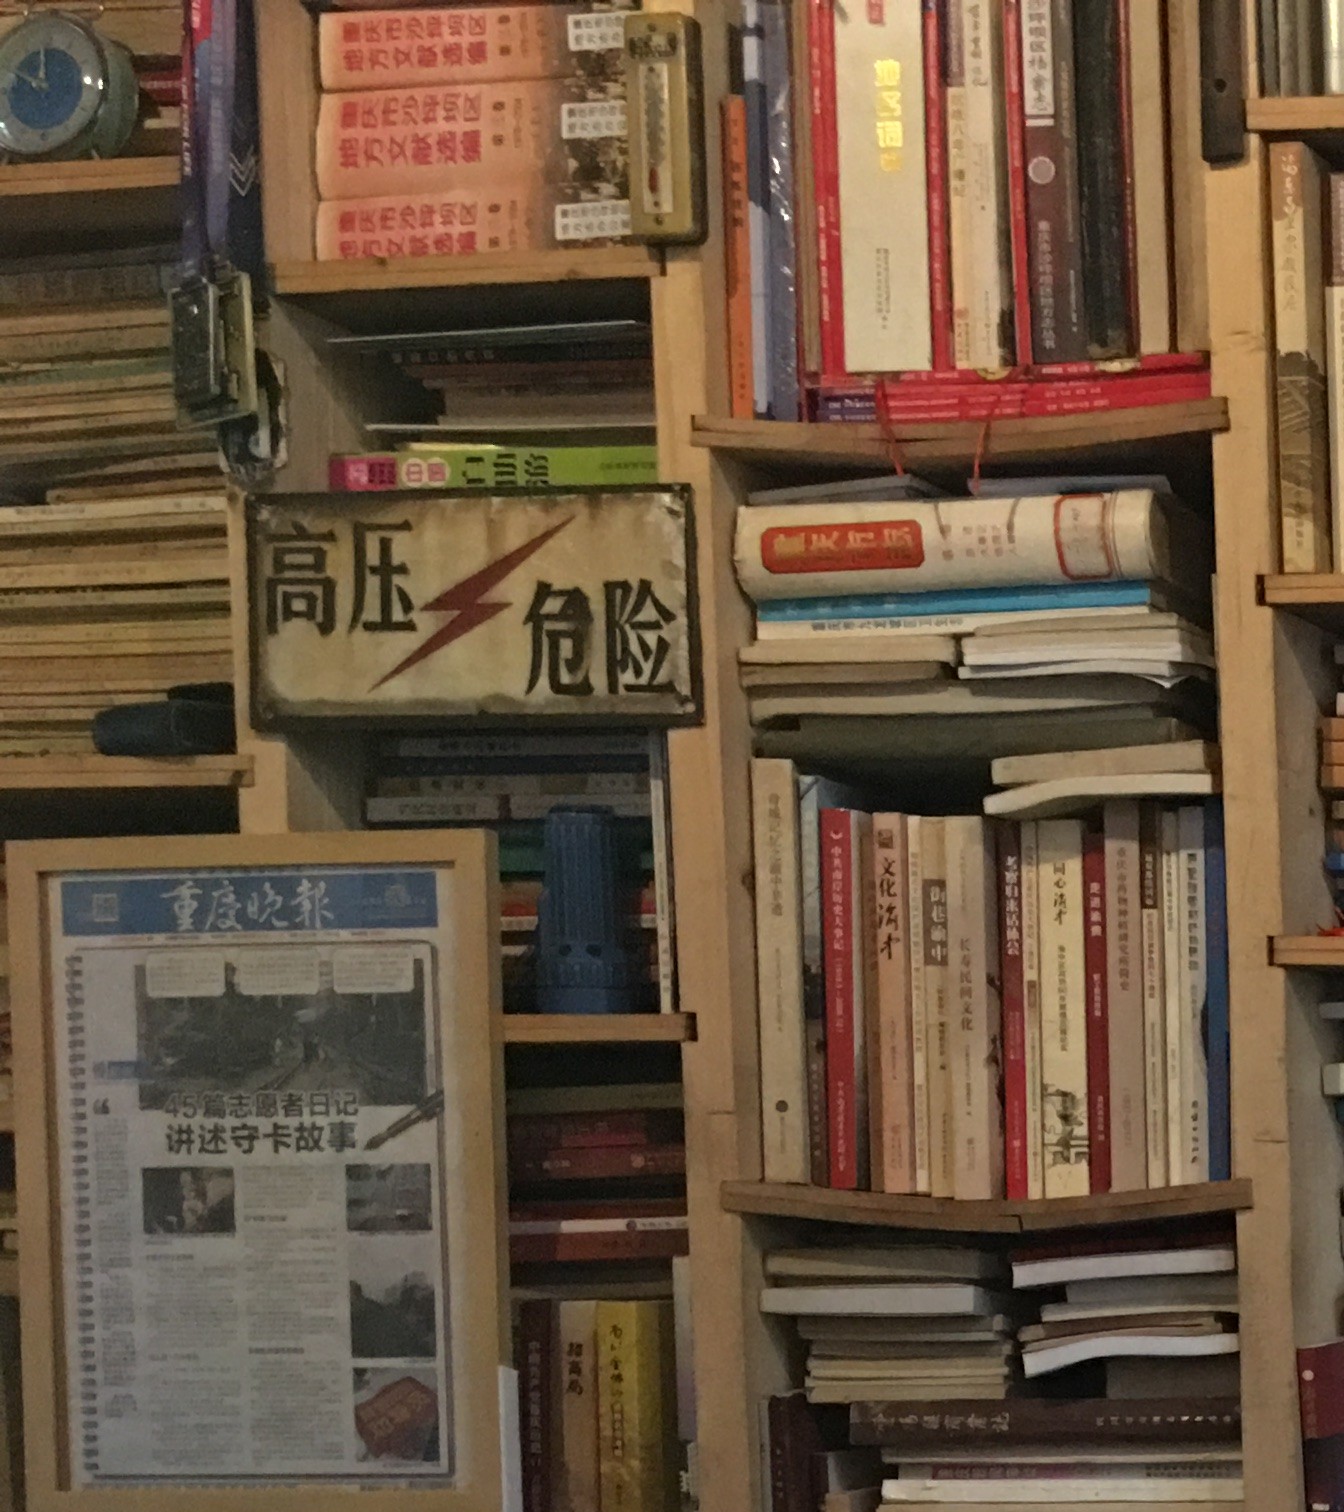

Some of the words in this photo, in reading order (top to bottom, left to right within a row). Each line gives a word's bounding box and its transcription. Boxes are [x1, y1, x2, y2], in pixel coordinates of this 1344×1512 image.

[343, 42, 488, 72] 地方文献选编
[341, 92, 482, 130] 重庆市沙坪坝区
[340, 129, 482, 169] 地方文献选编
[263, 518, 417, 638] 高压
[523, 577, 679, 698] 危险
[164, 1121, 360, 1157] 讲述守卡故事
